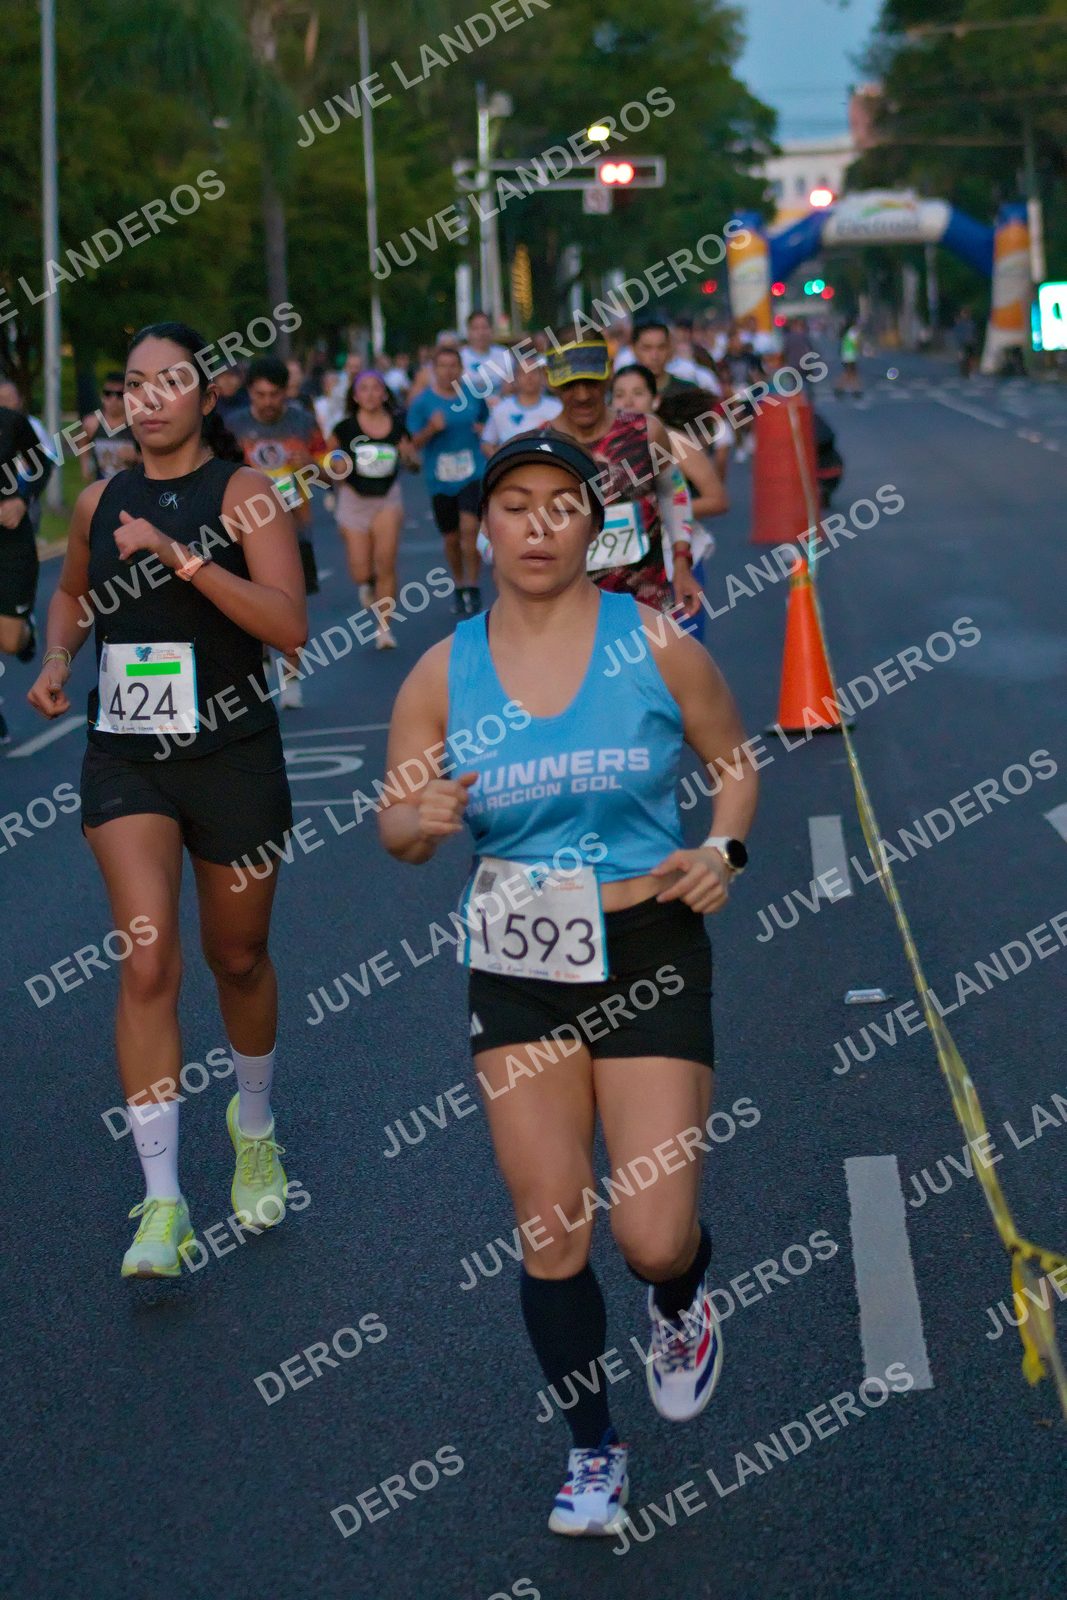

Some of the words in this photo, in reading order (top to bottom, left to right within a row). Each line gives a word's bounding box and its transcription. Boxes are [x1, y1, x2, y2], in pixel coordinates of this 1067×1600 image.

[109, 681, 178, 721] 424
[571, 775, 622, 794] GDL
[476, 907, 596, 966] 1593
